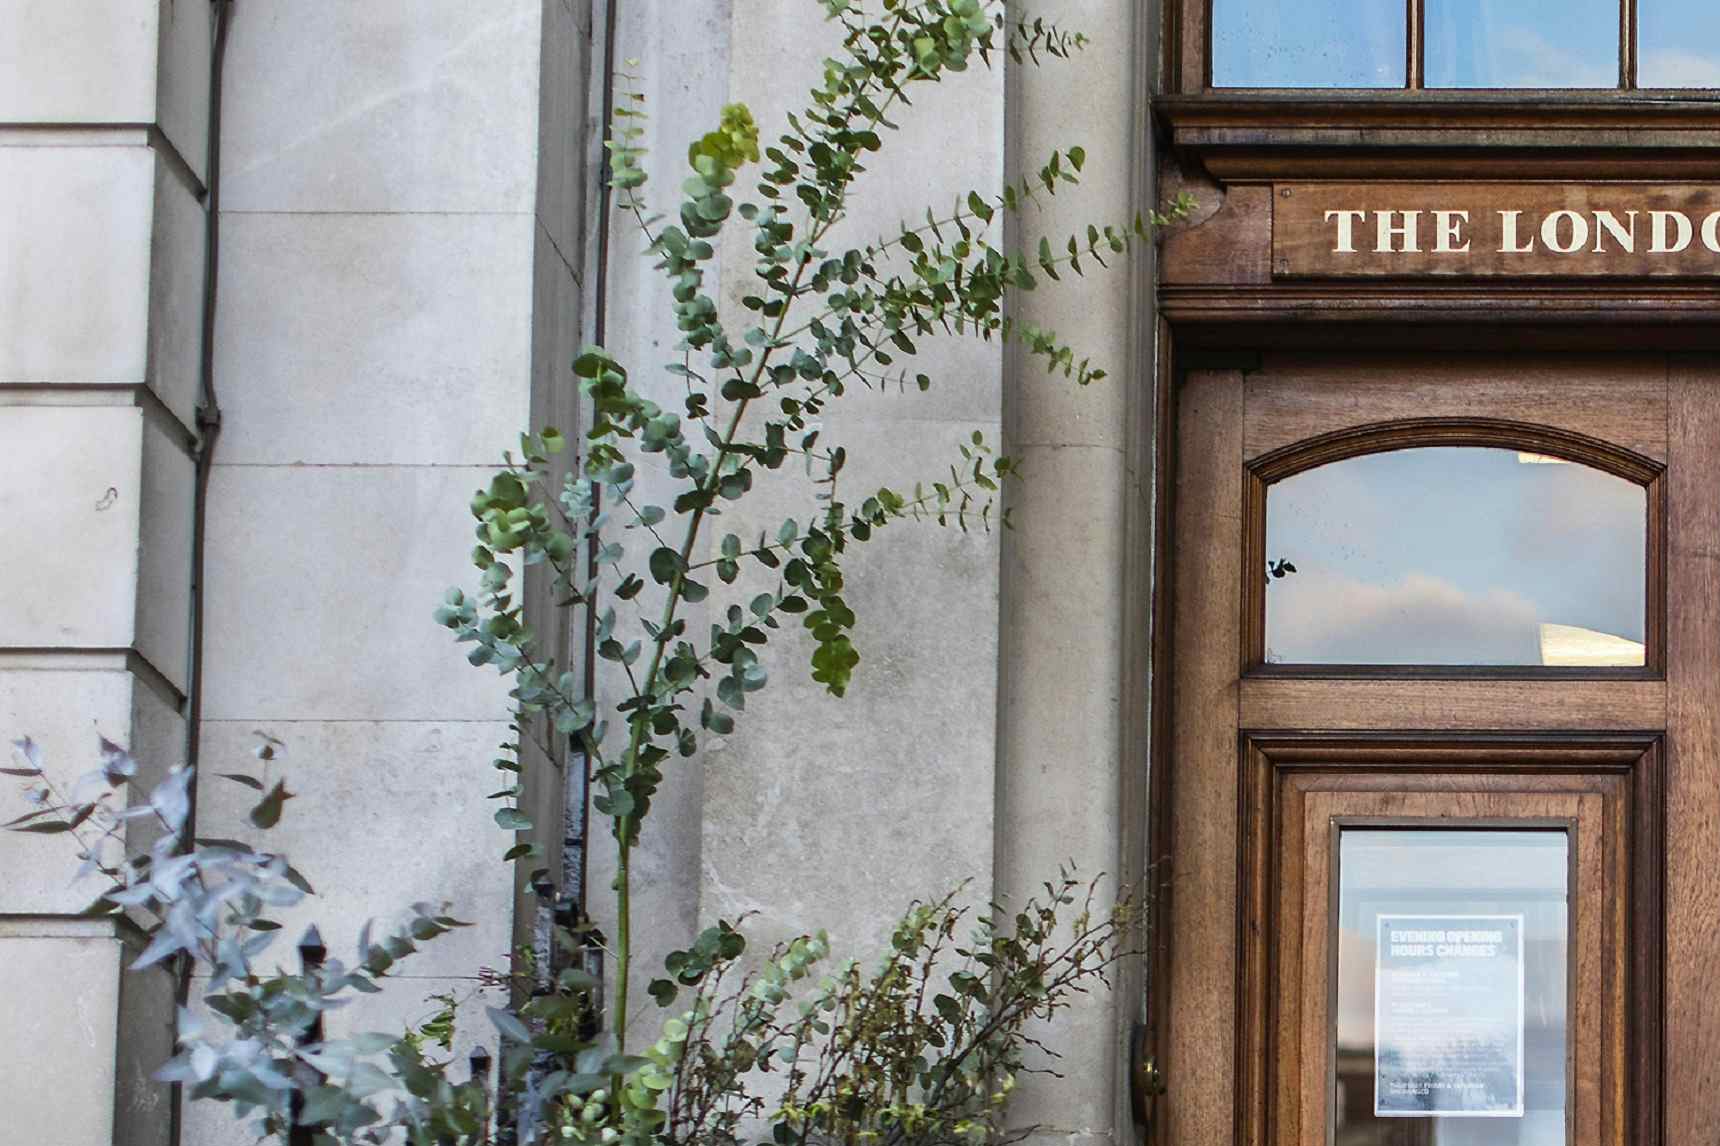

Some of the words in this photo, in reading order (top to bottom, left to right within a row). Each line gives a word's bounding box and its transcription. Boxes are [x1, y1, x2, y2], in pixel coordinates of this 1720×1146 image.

[1323, 209, 1472, 254] THE
[1390, 930, 1445, 943] EVENING
[1446, 930, 1503, 943] OPENING
[1390, 944, 1434, 957] HOURS
[1436, 944, 1497, 957] CHANGES
